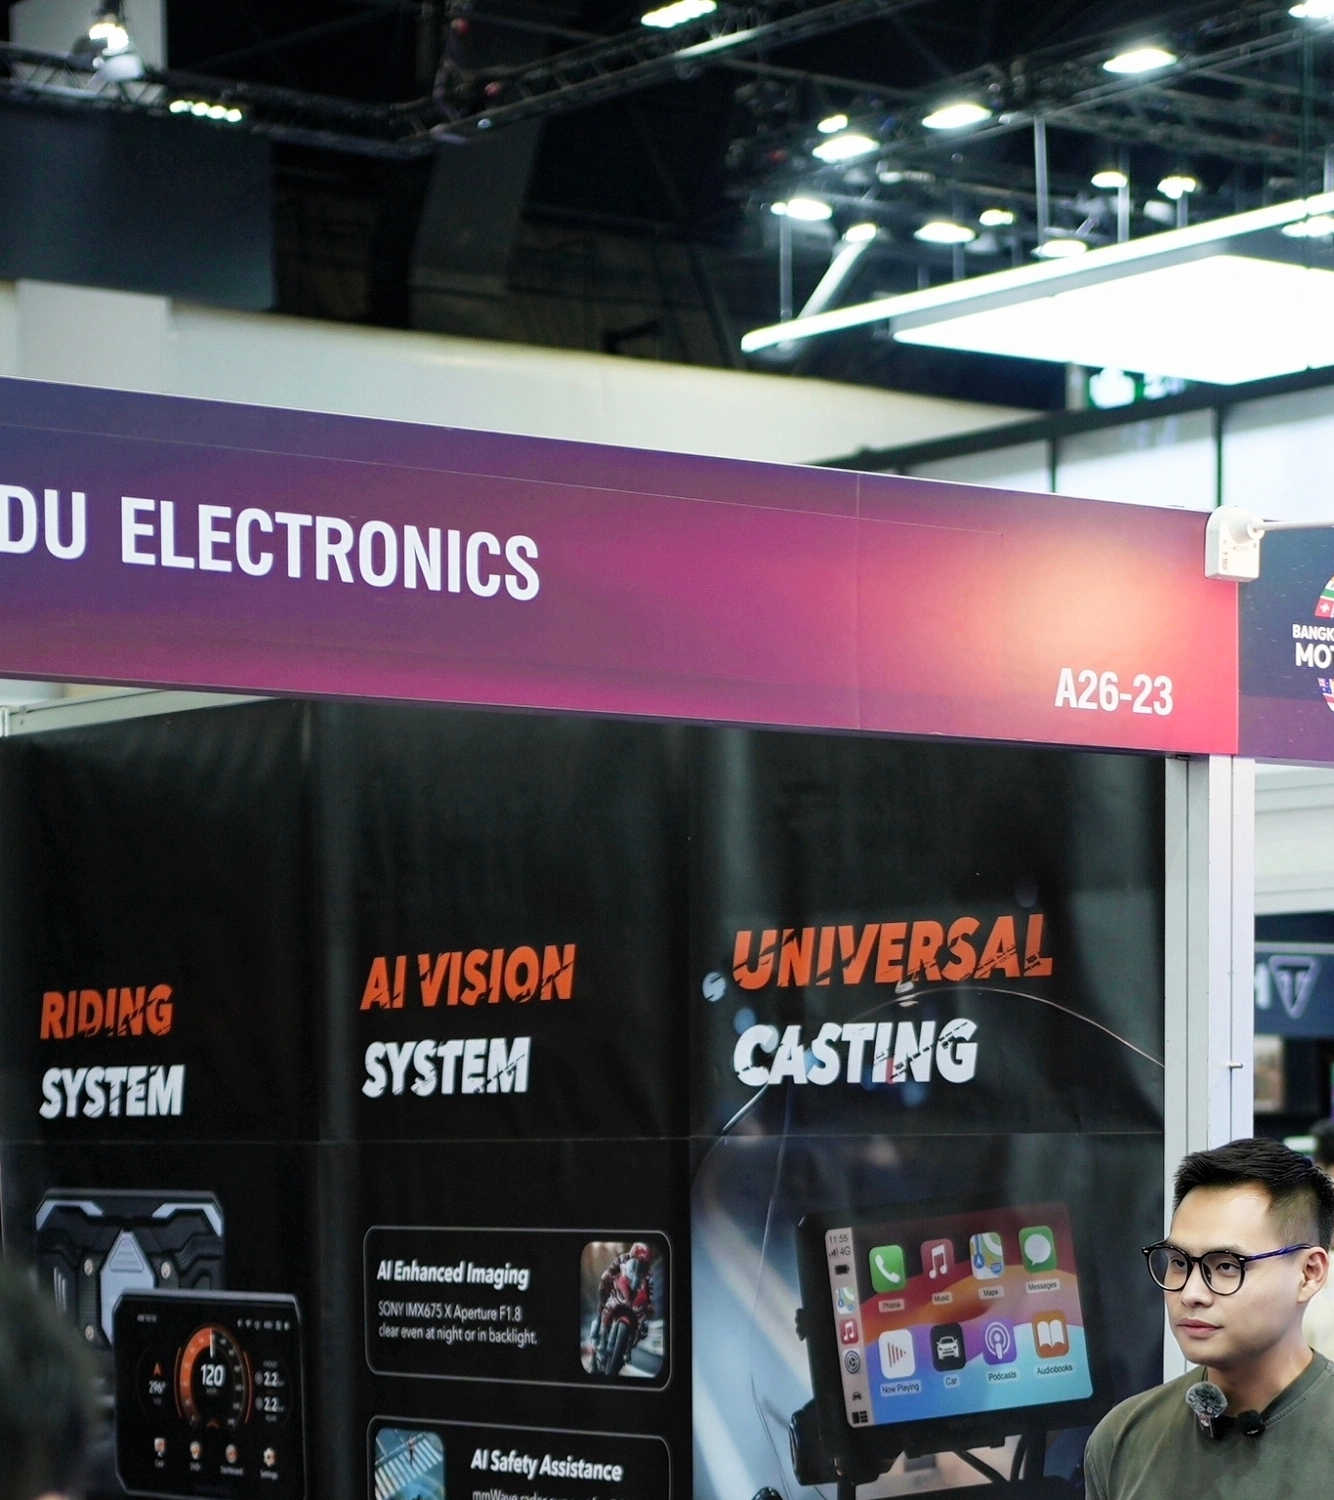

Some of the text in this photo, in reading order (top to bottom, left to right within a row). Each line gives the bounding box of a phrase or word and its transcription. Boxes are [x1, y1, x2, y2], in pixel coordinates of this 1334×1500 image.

[120, 496, 540, 602] ELECTRONICS
[1055, 666, 1174, 717] A26-23
[732, 912, 1054, 991] UNIVERSAL
[361, 943, 577, 1012] AI VISION
[39, 984, 175, 1041] RIDING
[732, 1017, 979, 1088] CASTING
[361, 1036, 532, 1099] SYSTEM
[38, 1064, 186, 1119] SYSTEM
[828, 1234, 849, 1245] 11:55
[376, 1260, 530, 1291] AI Enhanced Imaging
[1027, 1280, 1058, 1293] Messages
[933, 1293, 951, 1303] Music
[982, 1288, 999, 1299] Maps
[378, 1301, 522, 1323] SONY IMX675 X Aperture F1.8
[882, 1301, 901, 1311] Phone
[378, 1322, 538, 1348] clear even at night or in backlight.
[200, 1364, 225, 1387] 120
[263, 1372, 279, 1387] 2.2
[988, 1370, 1017, 1381] Podcasts
[1036, 1363, 1073, 1375] Audiobooks
[881, 1382, 920, 1395] Now Playing
[945, 1375, 958, 1386] Car
[263, 1397, 279, 1412] 2.2
[470, 1449, 623, 1482] AI Safety Assistance
